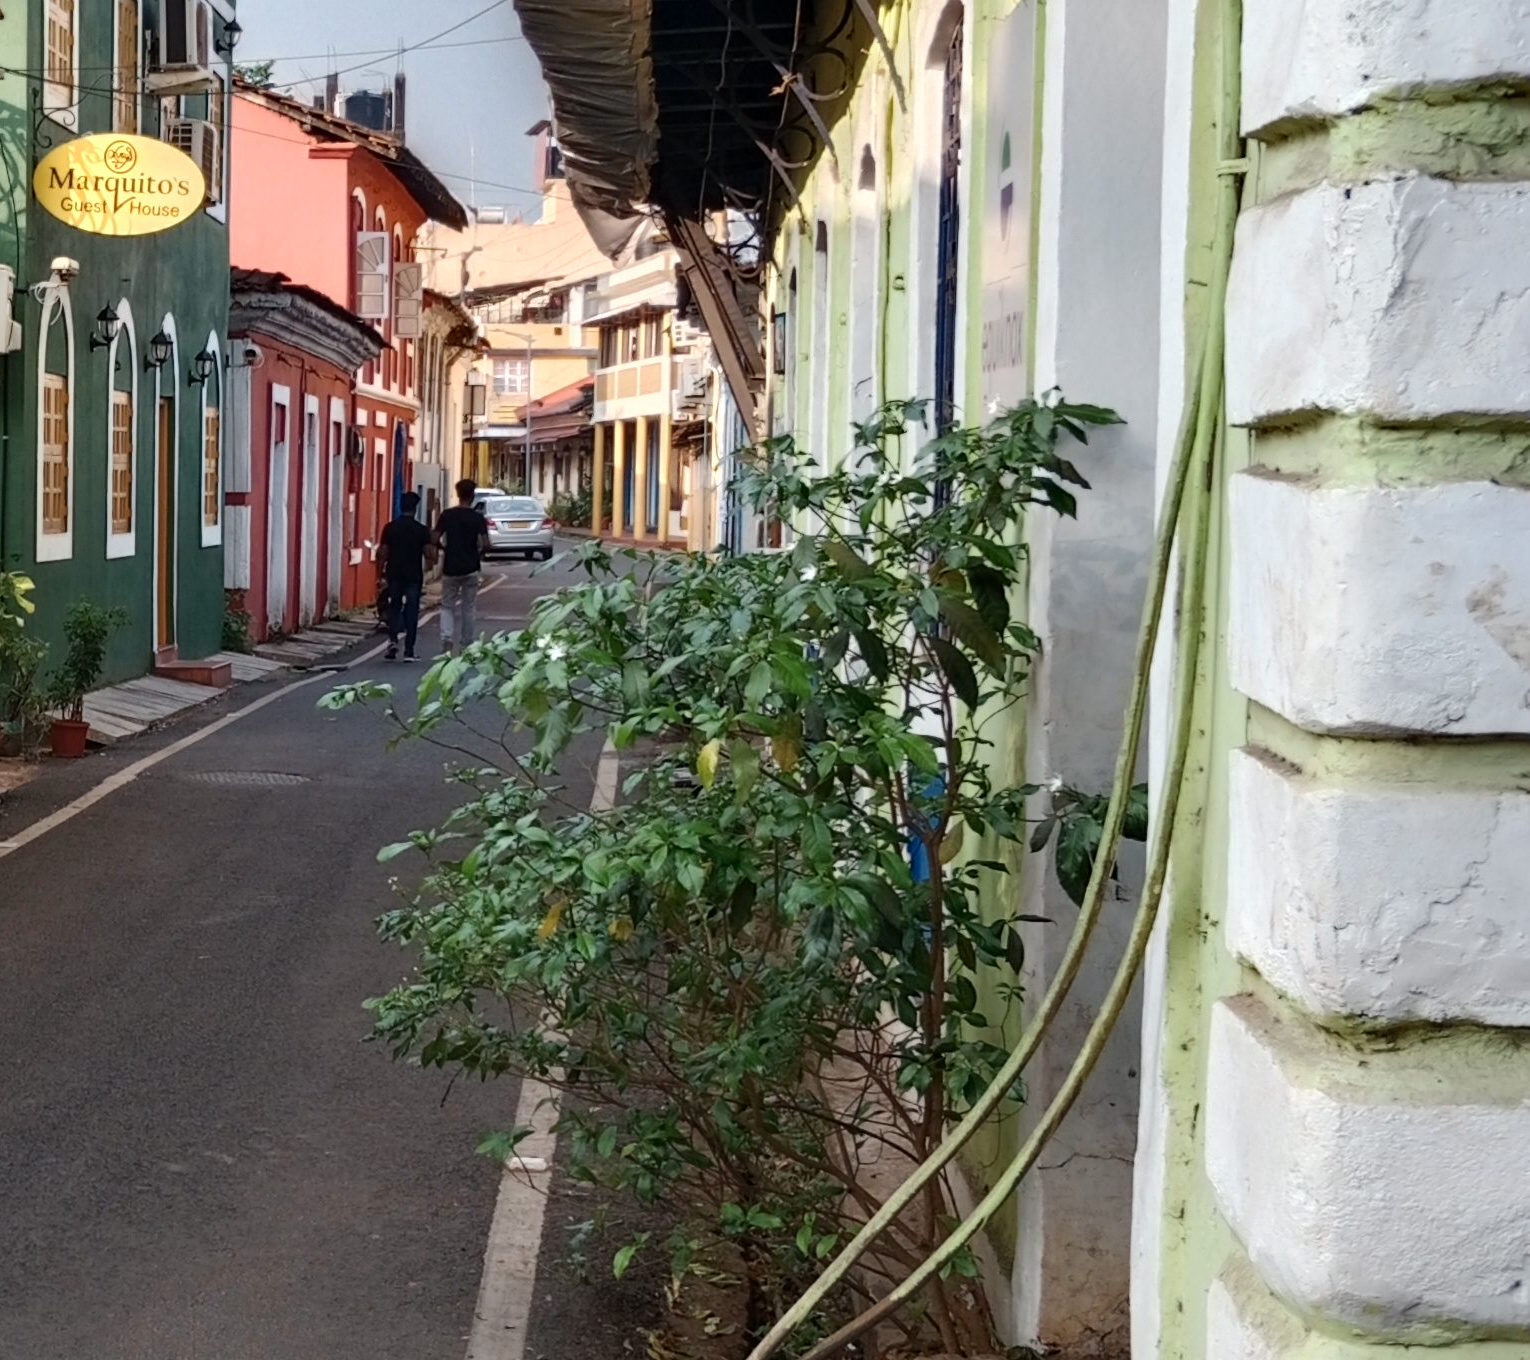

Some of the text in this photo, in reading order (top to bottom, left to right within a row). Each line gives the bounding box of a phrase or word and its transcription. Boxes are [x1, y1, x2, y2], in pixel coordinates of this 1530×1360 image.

[48, 166, 190, 215] Marquito's
[60, 196, 180, 218] Guest House
